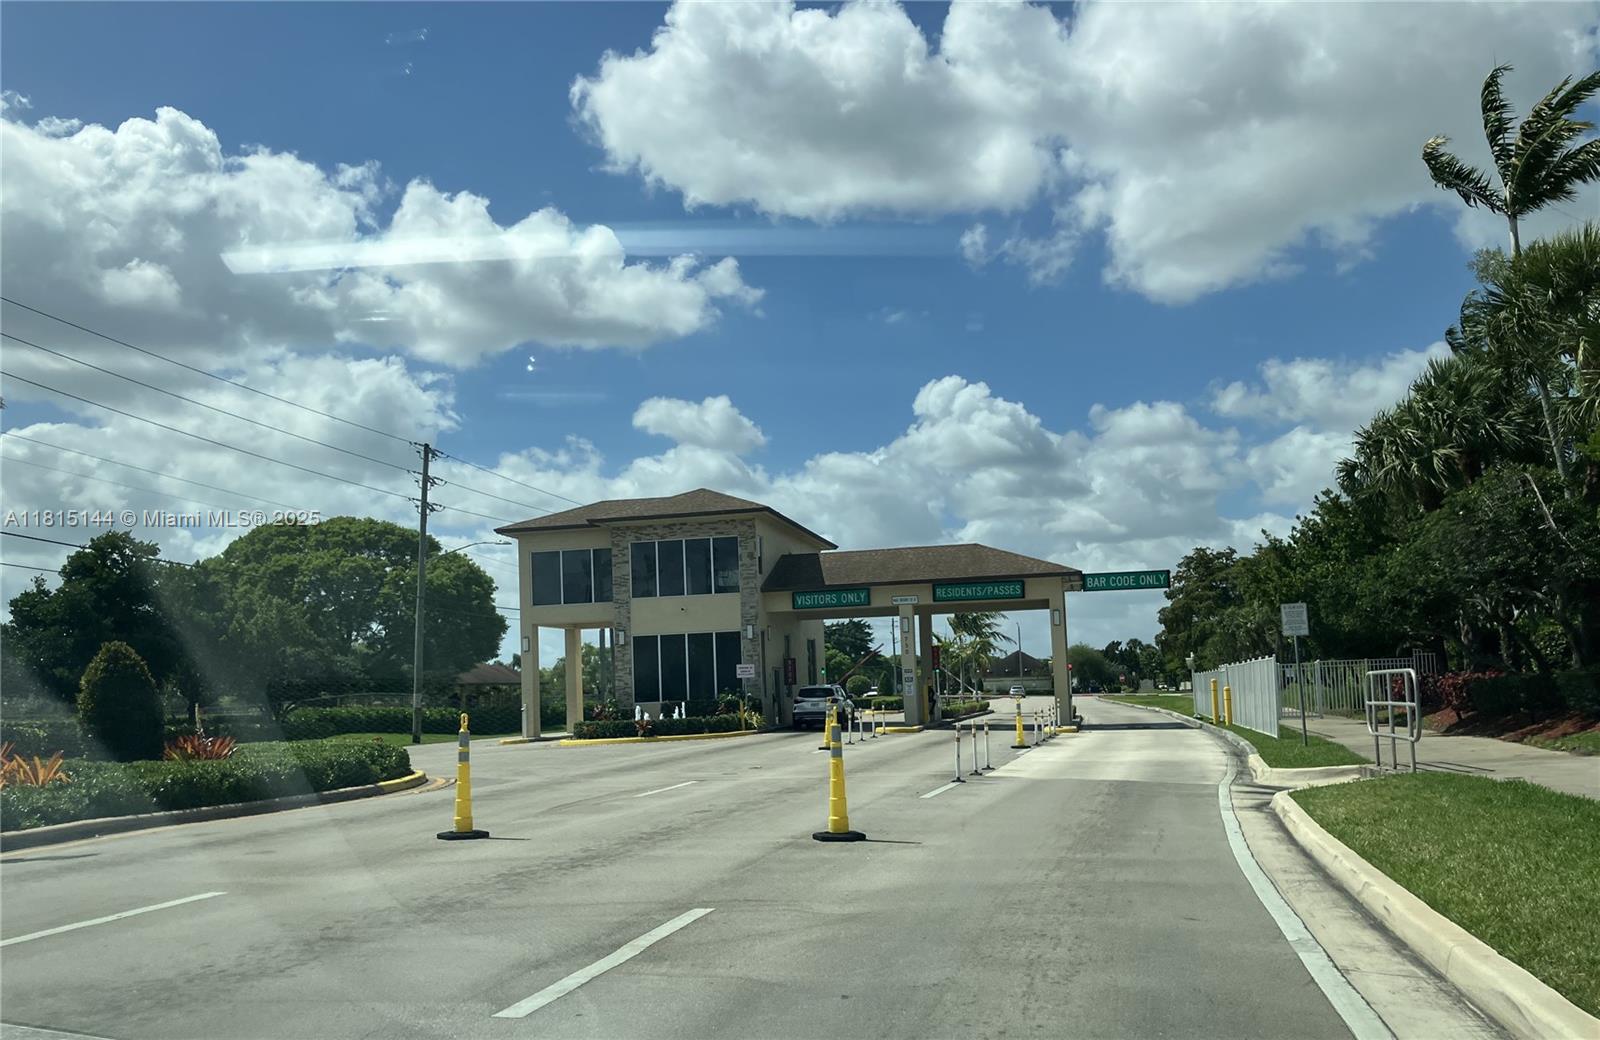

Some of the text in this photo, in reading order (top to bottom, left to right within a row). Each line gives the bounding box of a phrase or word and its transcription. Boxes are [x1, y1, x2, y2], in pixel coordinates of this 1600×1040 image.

[1087, 574, 1166, 588] BAR CODE ONLY
[935, 585, 1022, 598] RESIDENTS/PASSES
[796, 592, 865, 605] VISITORS ONLY
